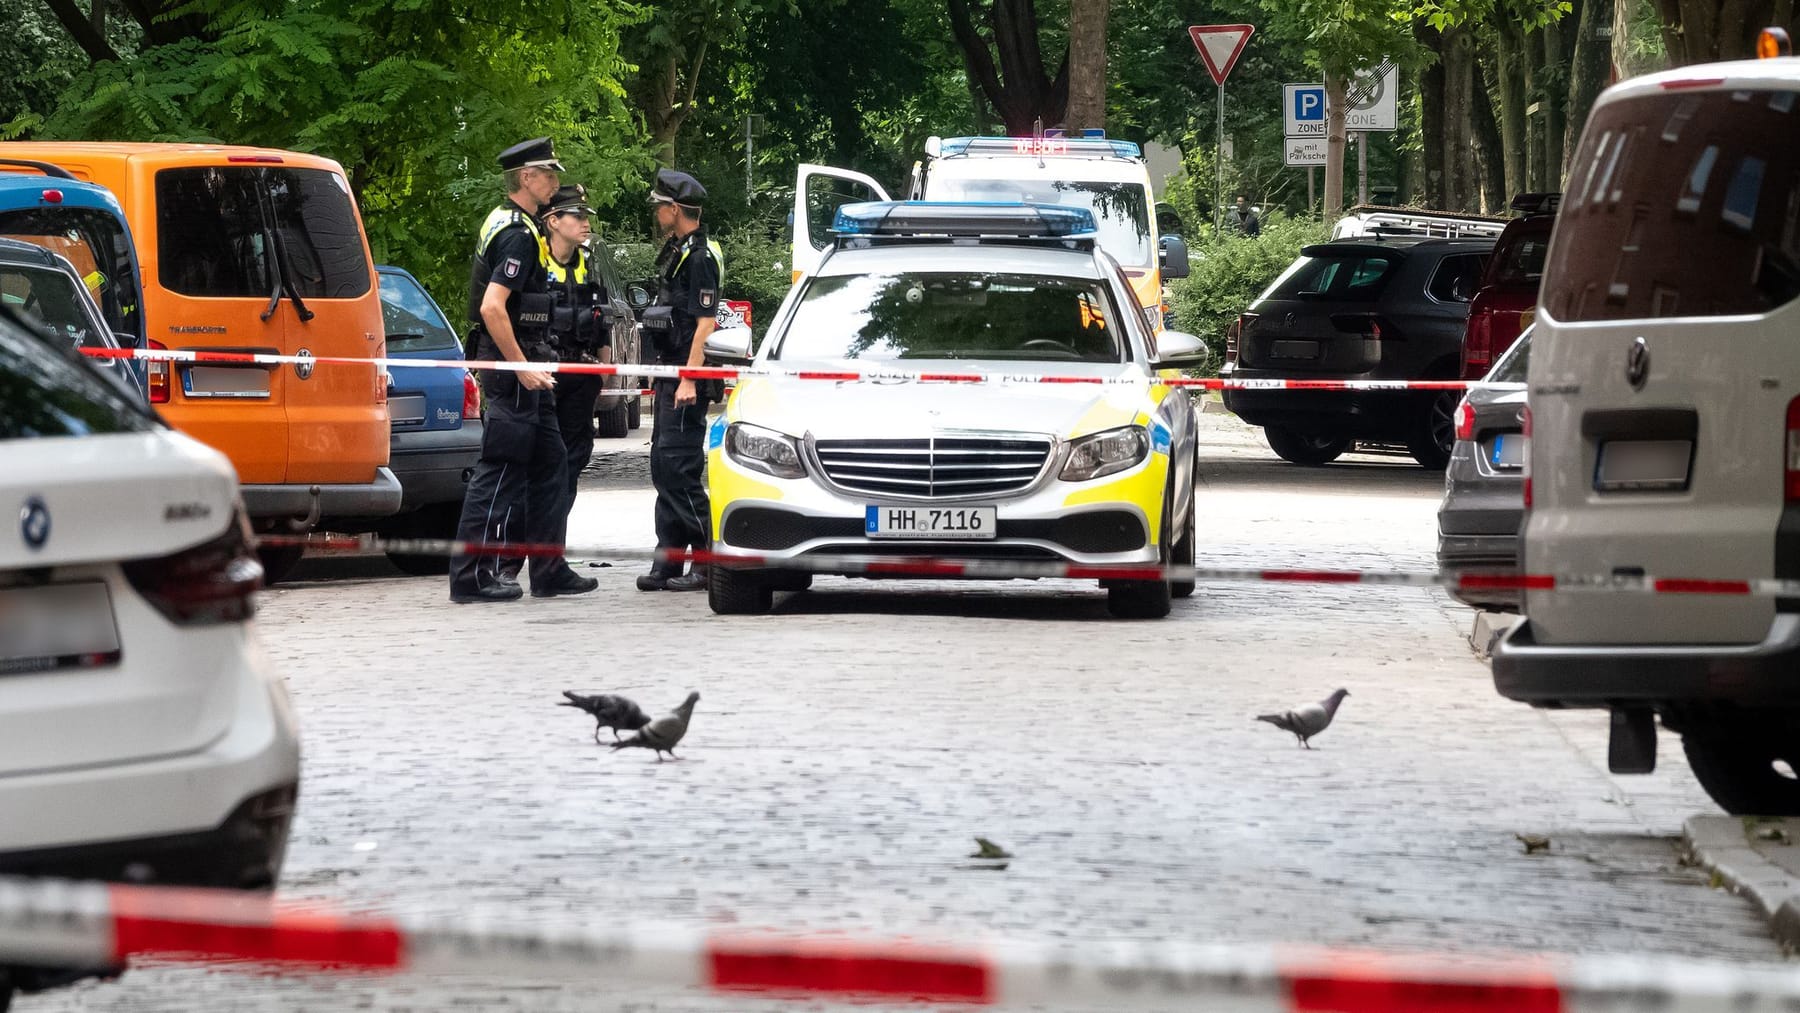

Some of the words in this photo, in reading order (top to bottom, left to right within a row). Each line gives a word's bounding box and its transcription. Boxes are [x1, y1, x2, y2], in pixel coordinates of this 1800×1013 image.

[1302, 93, 1318, 117] P
[1345, 114, 1377, 125] ZONE
[1298, 123, 1324, 133] ZONE
[1304, 143, 1318, 151] mit
[1289, 152, 1327, 160] Parksche
[519, 312, 549, 322] POLIZEI
[888, 510, 916, 530] HH
[929, 510, 982, 530] 7116
